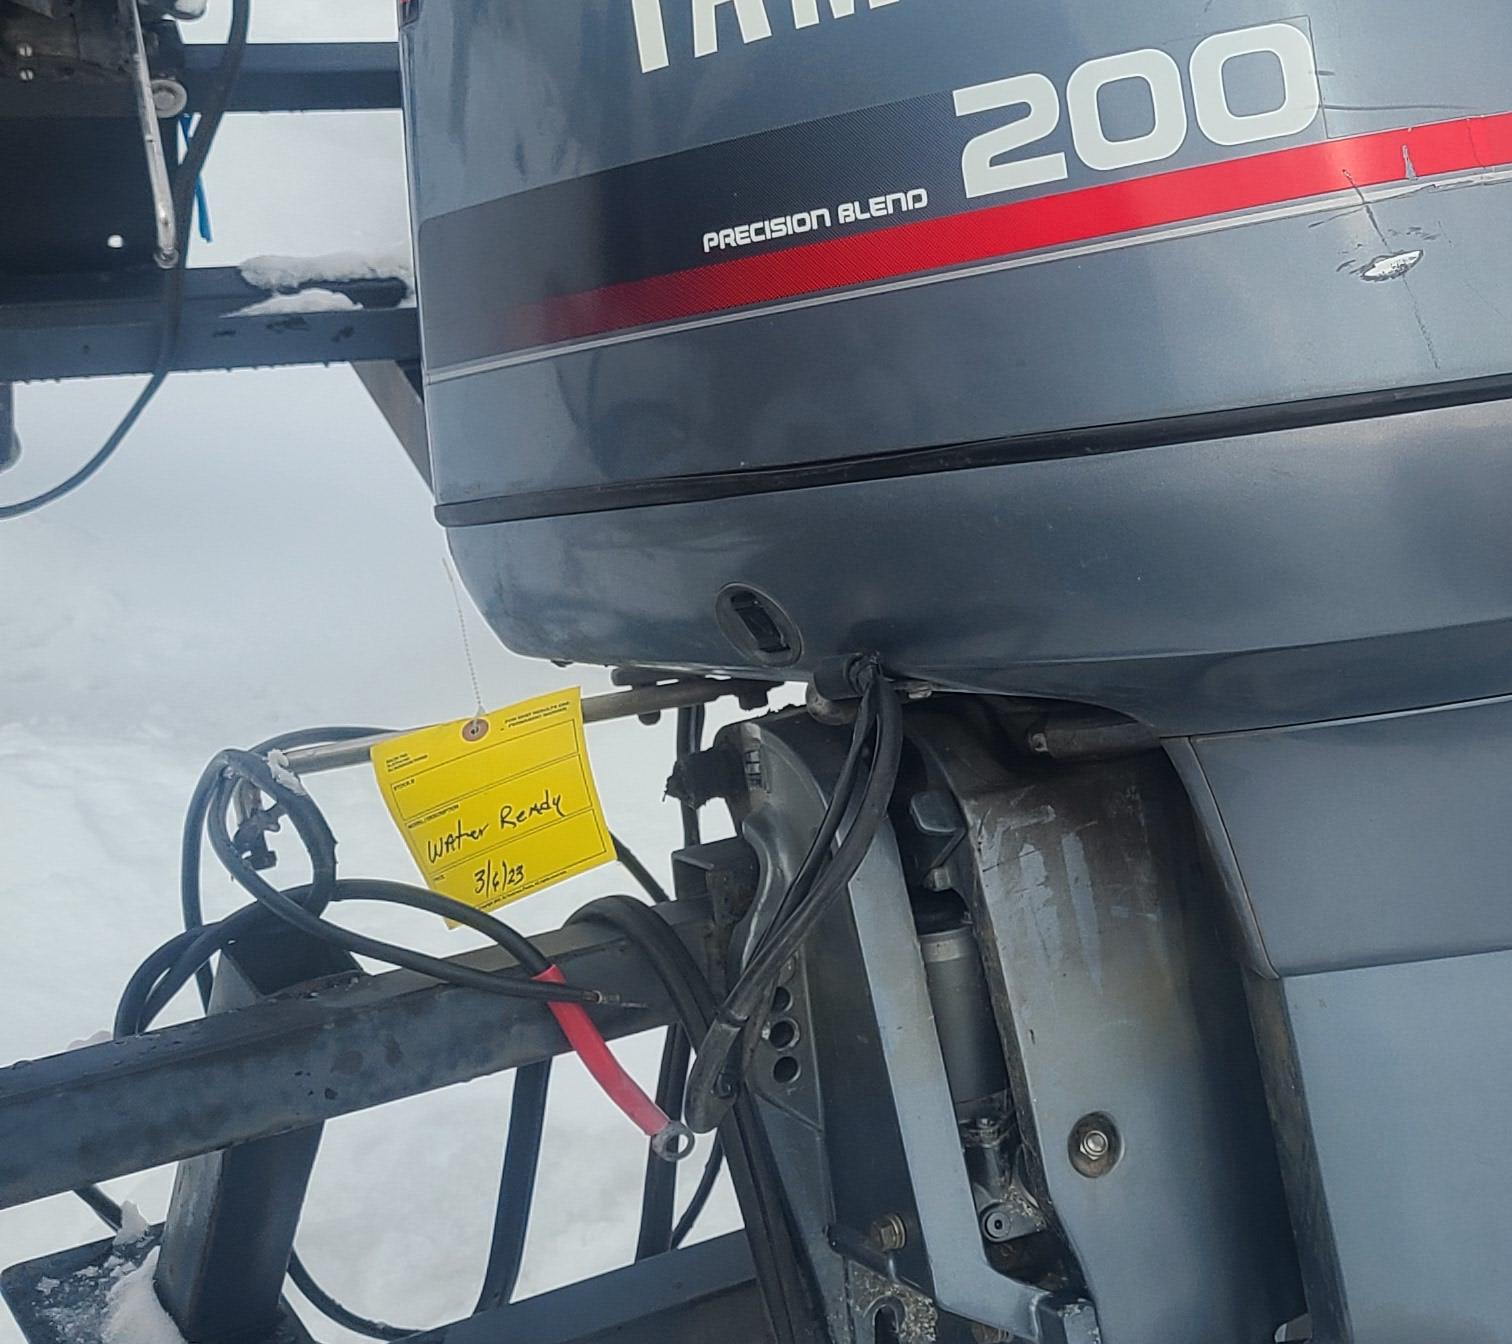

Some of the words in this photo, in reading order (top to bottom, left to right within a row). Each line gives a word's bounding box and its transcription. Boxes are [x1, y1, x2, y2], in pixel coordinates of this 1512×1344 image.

[953, 23, 1320, 198] 200
[702, 207, 832, 253] PRECISION
[837, 187, 929, 224] BLEND
